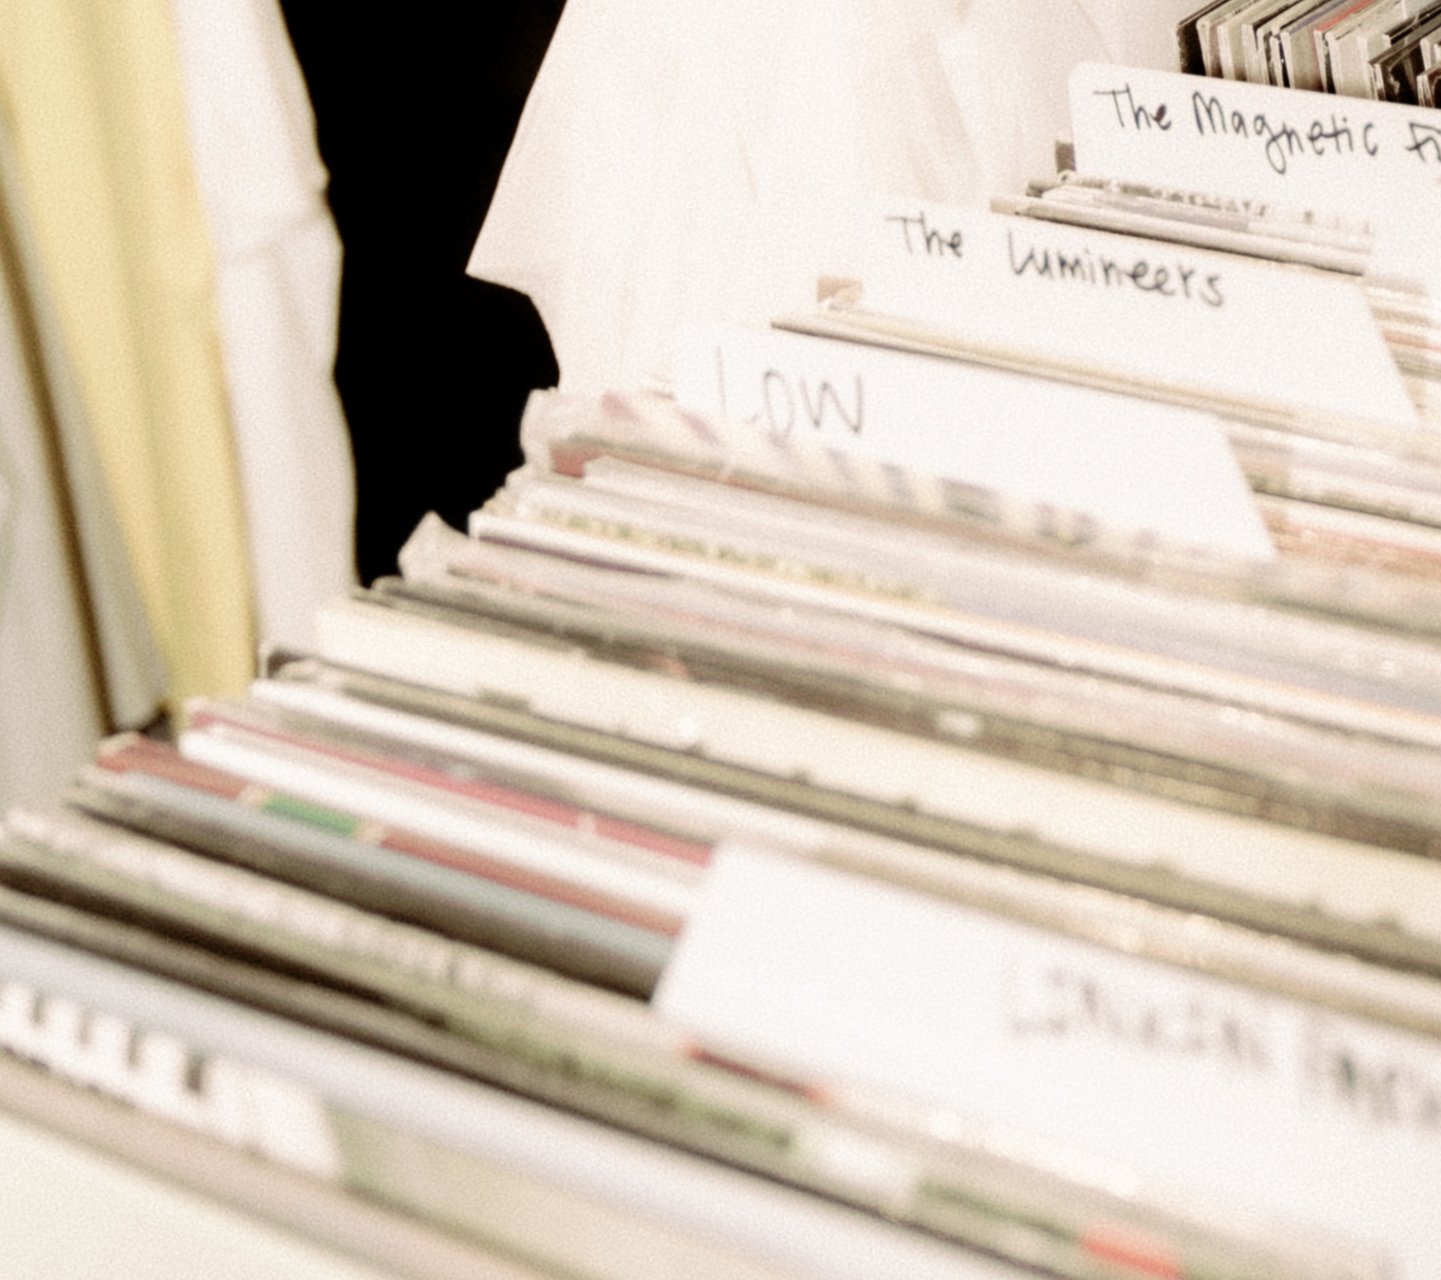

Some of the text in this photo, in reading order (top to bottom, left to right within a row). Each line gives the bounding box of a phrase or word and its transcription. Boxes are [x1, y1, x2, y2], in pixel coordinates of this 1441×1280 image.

[1092, 83, 1173, 132] The
[1192, 90, 1379, 174] Magnetic
[884, 211, 1224, 308] The Lumineers
